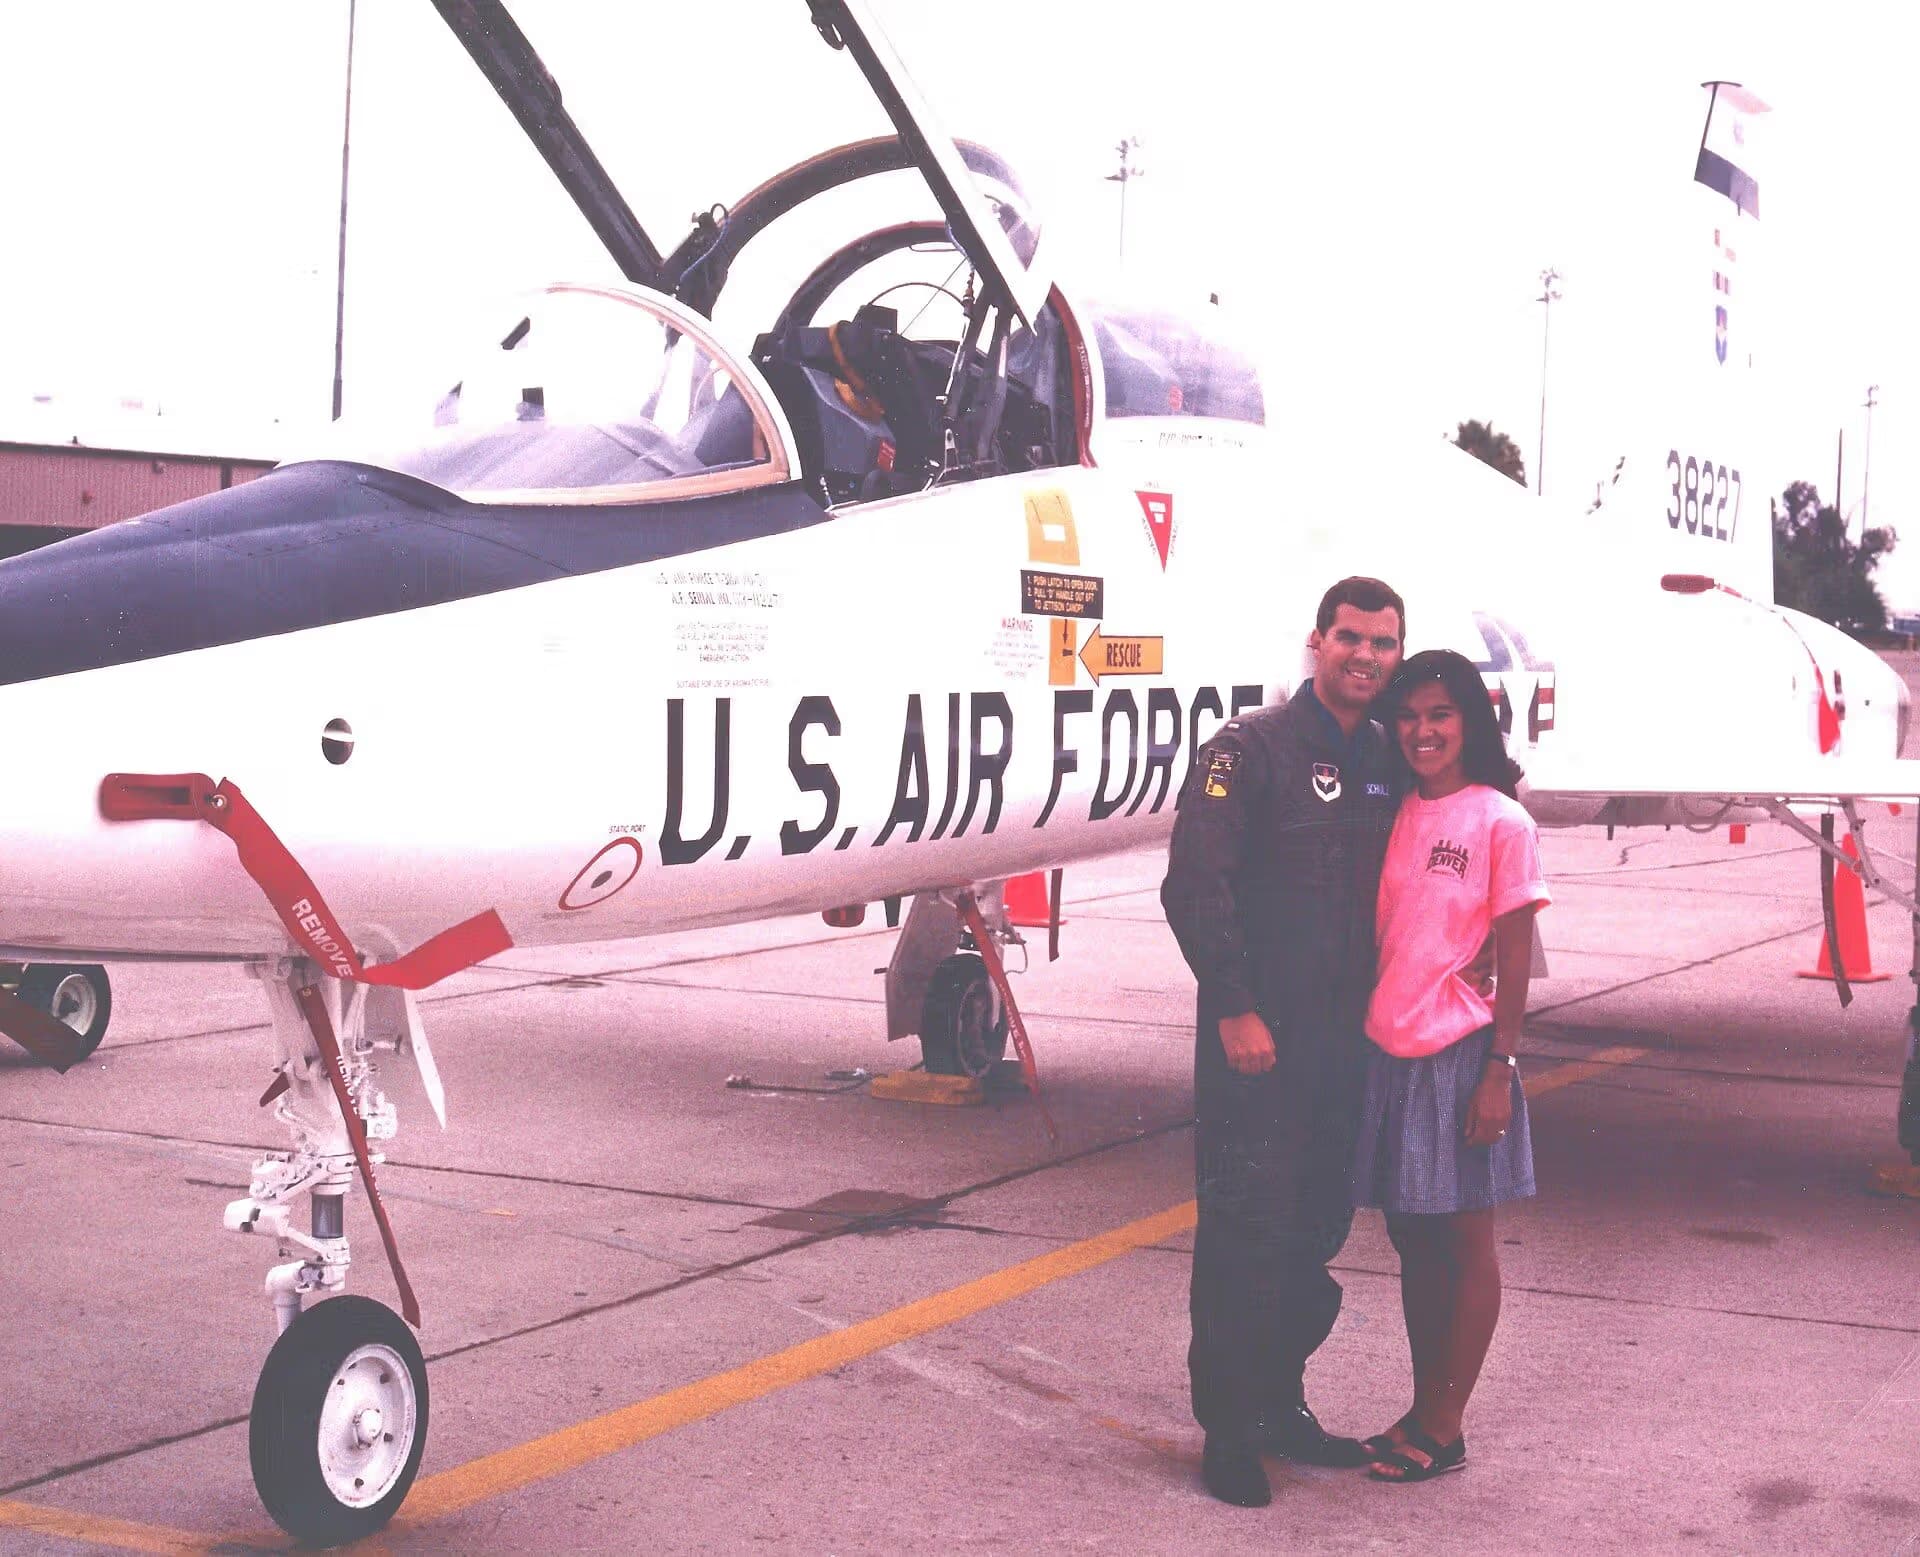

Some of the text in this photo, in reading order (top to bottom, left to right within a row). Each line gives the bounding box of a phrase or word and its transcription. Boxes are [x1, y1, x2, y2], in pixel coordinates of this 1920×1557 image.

[1667, 448, 1741, 544] 38227
[688, 591, 715, 605] SERIAL
[1001, 617, 1033, 632] WARNING
[1106, 643, 1141, 667] RESCUE
[871, 691, 1014, 847] AIR
[1033, 685, 1263, 828] FORC
[630, 824, 646, 833] PORT
[1426, 853, 1467, 879] DENVER
[292, 898, 353, 977] REMOVE
